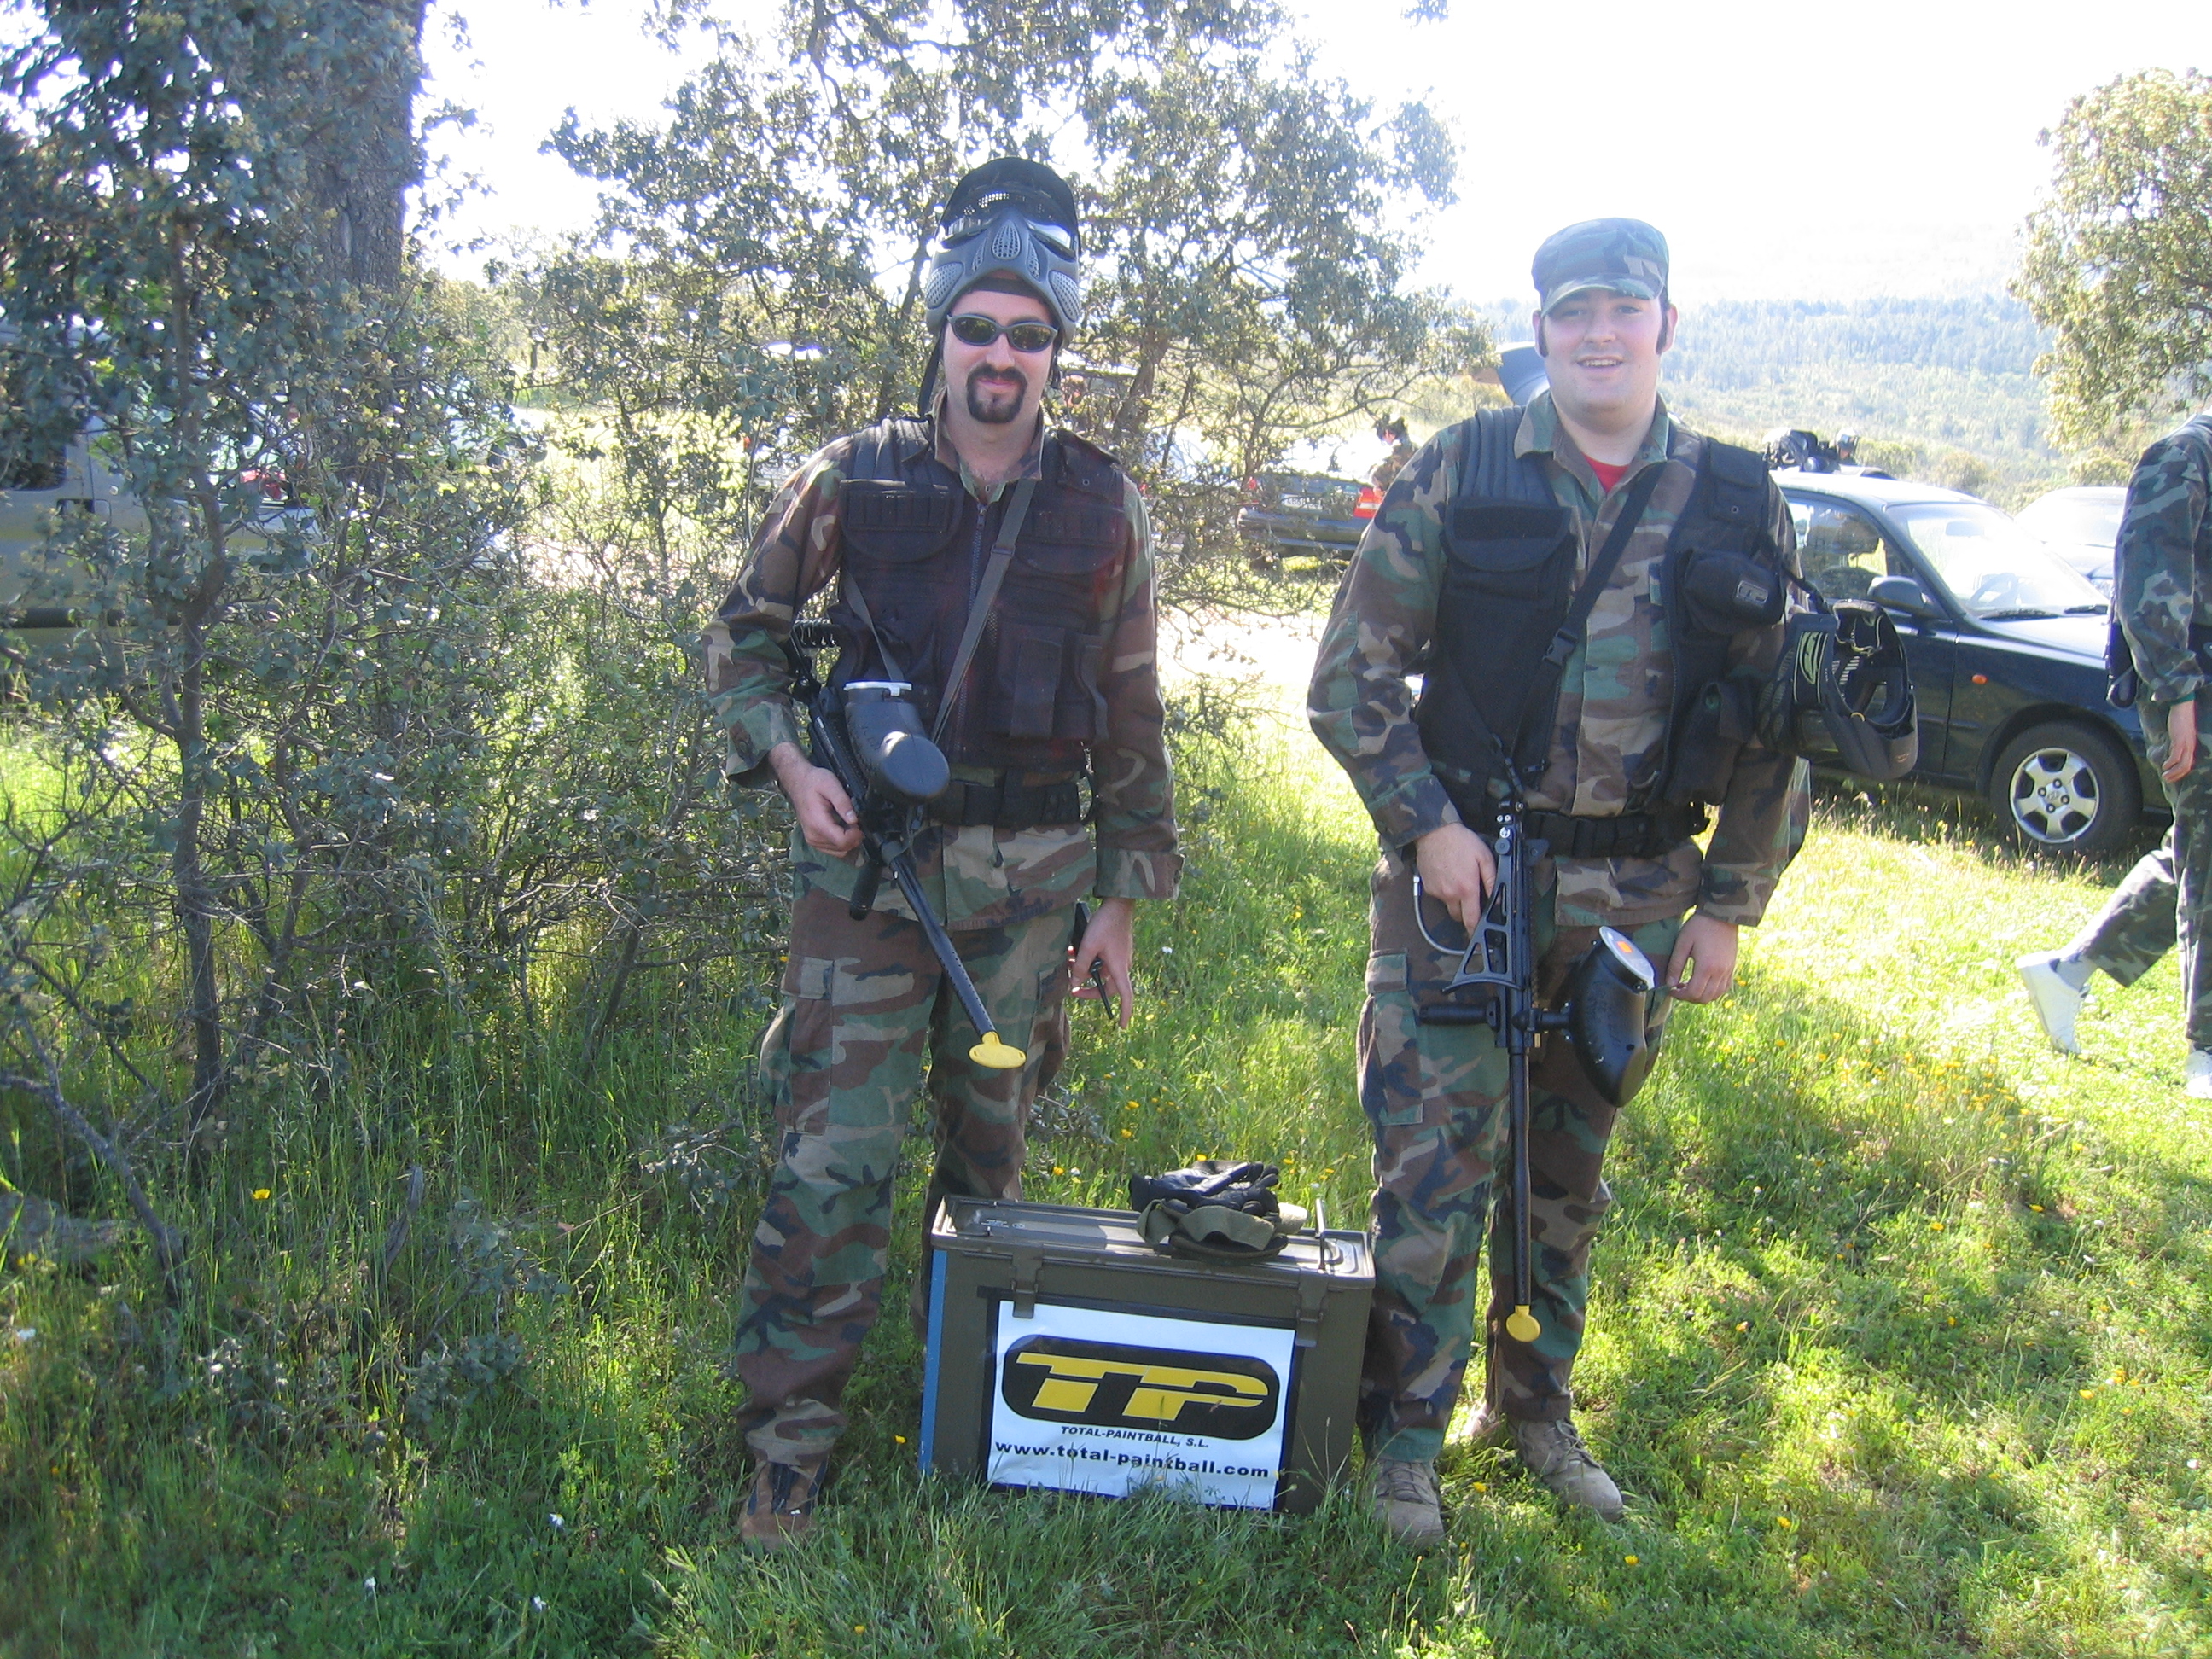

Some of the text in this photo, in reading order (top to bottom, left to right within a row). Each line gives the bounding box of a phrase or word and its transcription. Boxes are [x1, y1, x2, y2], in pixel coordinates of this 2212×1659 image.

[1061, 1426, 1209, 1448] TOTAL-PAINTBALL, S.L.
[995, 1441, 1269, 1477] www.total-paintball.com
